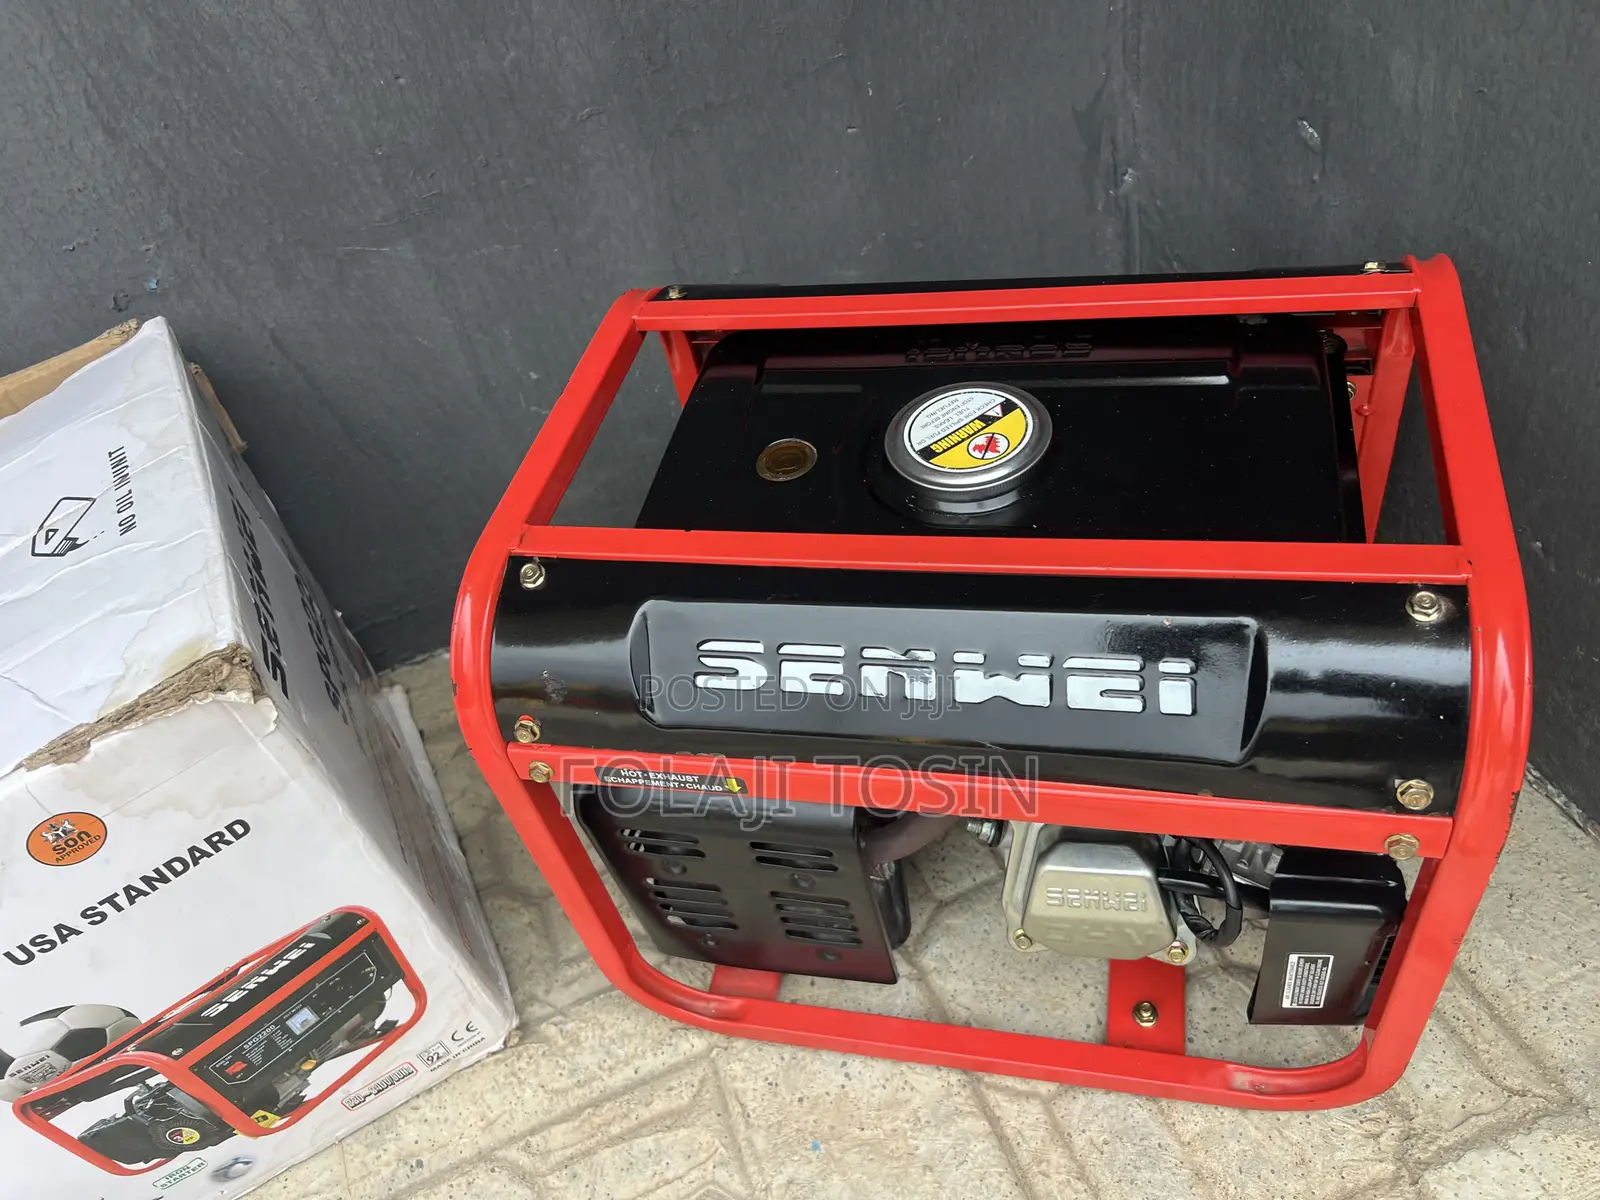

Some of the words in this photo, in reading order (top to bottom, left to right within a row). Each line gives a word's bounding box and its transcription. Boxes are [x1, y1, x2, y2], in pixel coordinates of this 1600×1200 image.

[977, 398, 996, 411] CHECK
[964, 409, 977, 420] FOR
[940, 417, 965, 433] SPILLED
[916, 438, 927, 446] OR
[926, 430, 941, 441] FUEL
[929, 418, 986, 454] WARNING
[115, 488, 134, 514] OIL
[118, 513, 137, 536] NO
[55, 834, 101, 863] APPROVED
[3, 922, 84, 966] USA
[80, 818, 251, 926] STANDARD
[160, 1161, 206, 1188] STARTER
[165, 1165, 191, 1180] IRON
